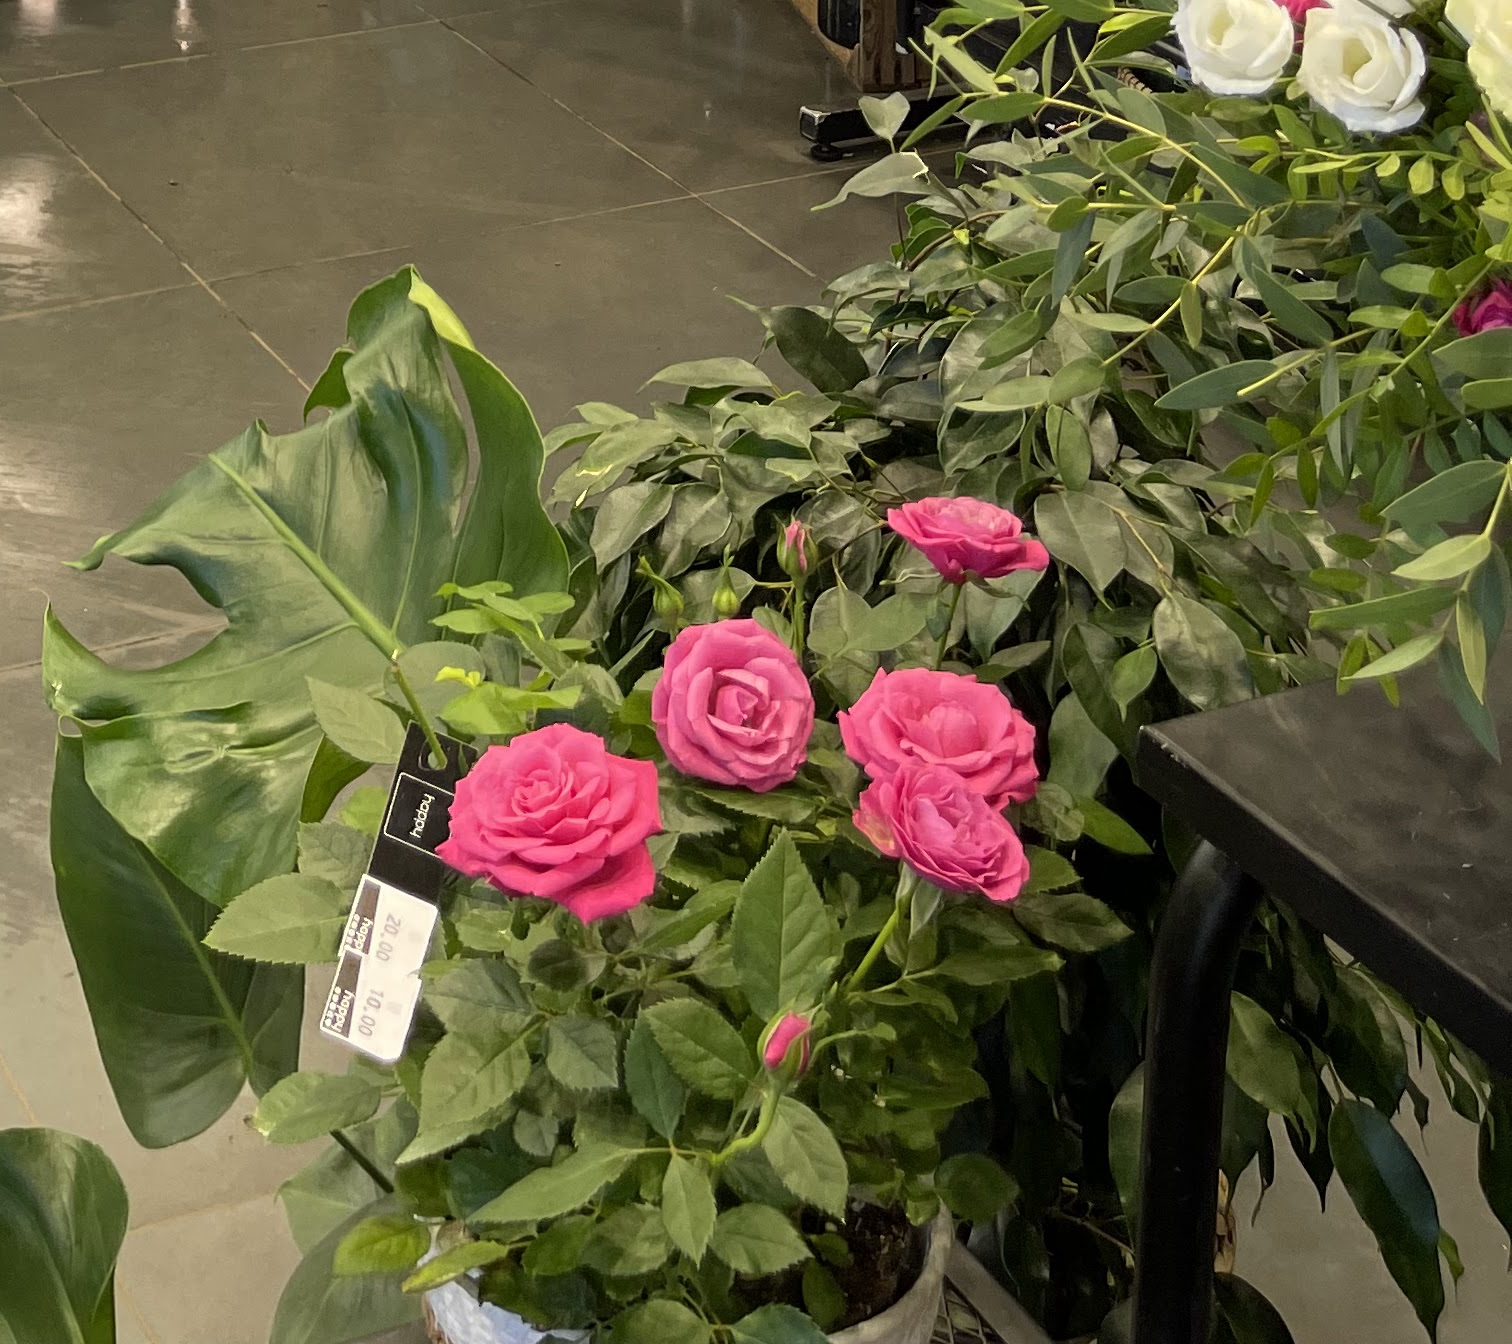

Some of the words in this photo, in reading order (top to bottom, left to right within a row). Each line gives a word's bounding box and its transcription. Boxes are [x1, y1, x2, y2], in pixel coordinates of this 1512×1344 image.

[409, 793, 436, 839] happy
[354, 917, 374, 952] happ
[375, 913, 402, 962] 20.00
[331, 989, 356, 1033] happy
[358, 988, 385, 1037] 10.00
